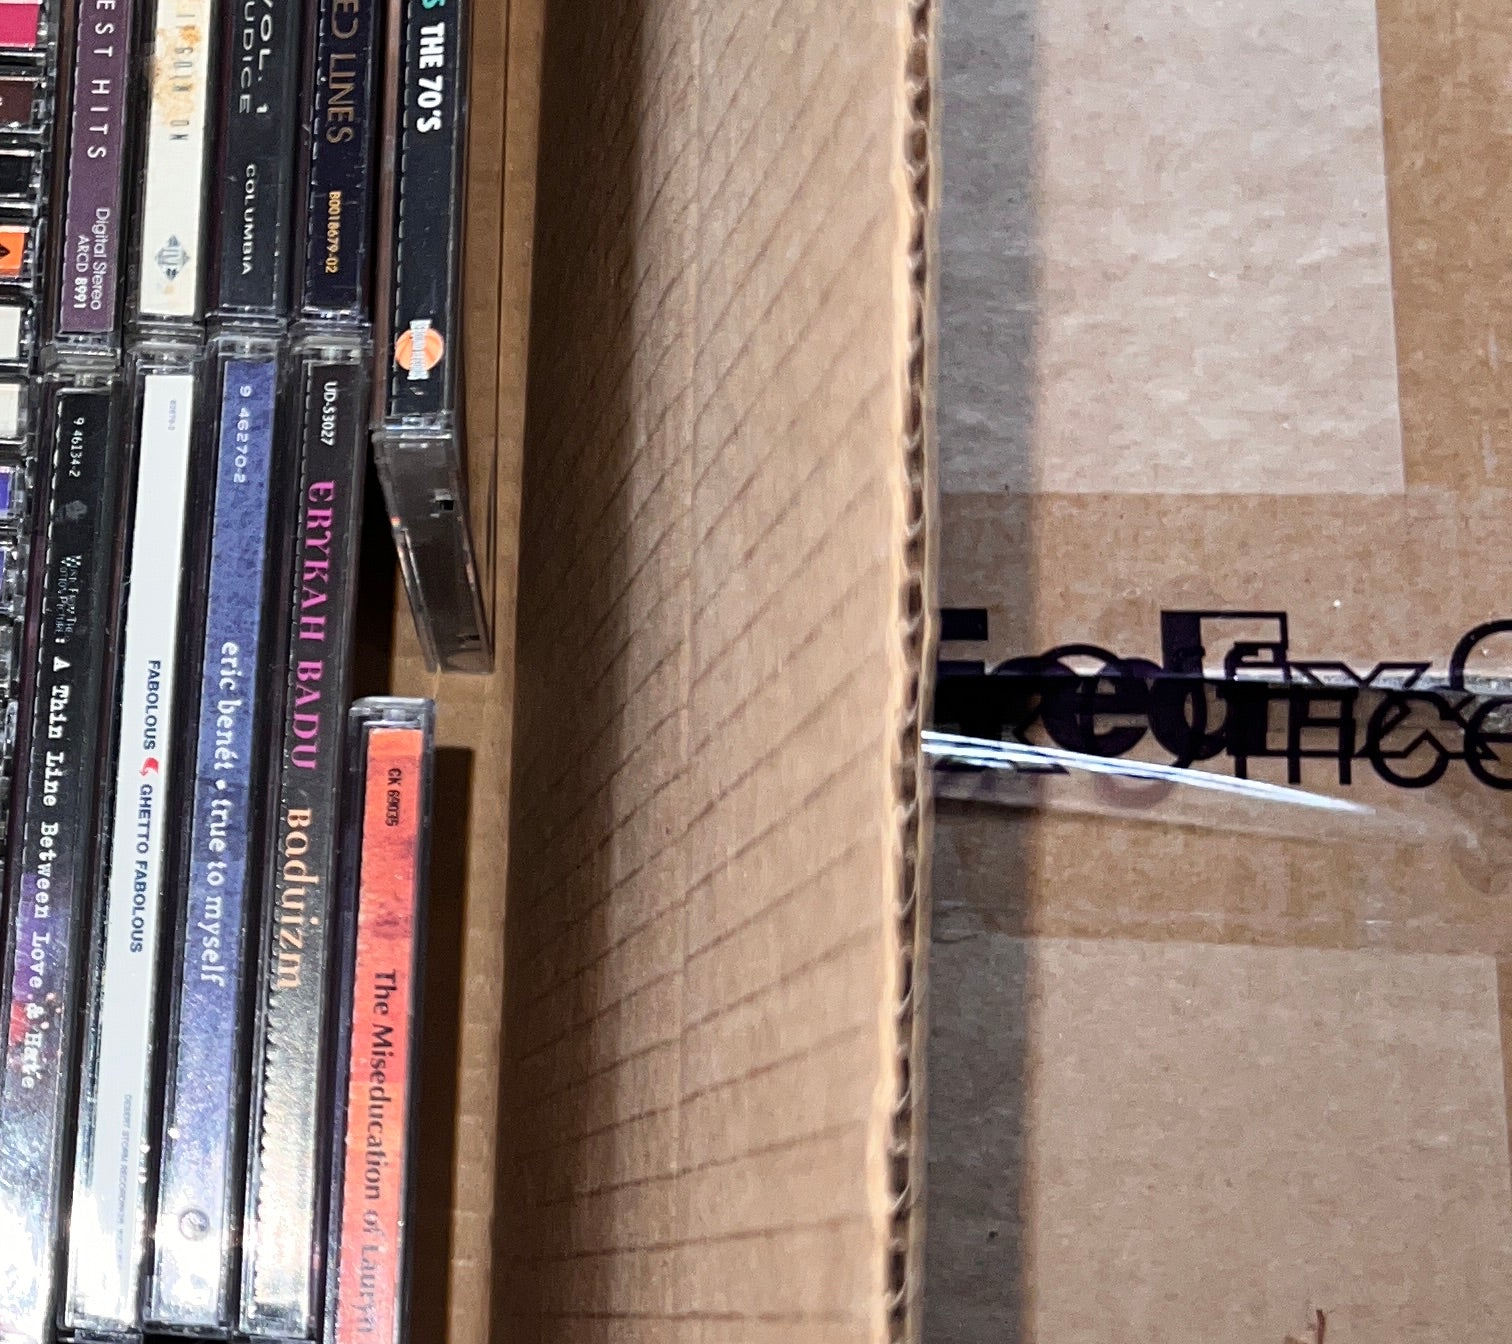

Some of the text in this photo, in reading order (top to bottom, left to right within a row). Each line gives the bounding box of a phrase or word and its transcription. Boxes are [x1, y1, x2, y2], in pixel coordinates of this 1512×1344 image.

[418, 22, 445, 70] THE
[325, 53, 356, 143] LINES
[416, 79, 443, 133] 70'S
[291, 480, 336, 769] ERYKAH BADU
[129, 660, 161, 953] FABOLOUS GHETTO FABOLOUS
